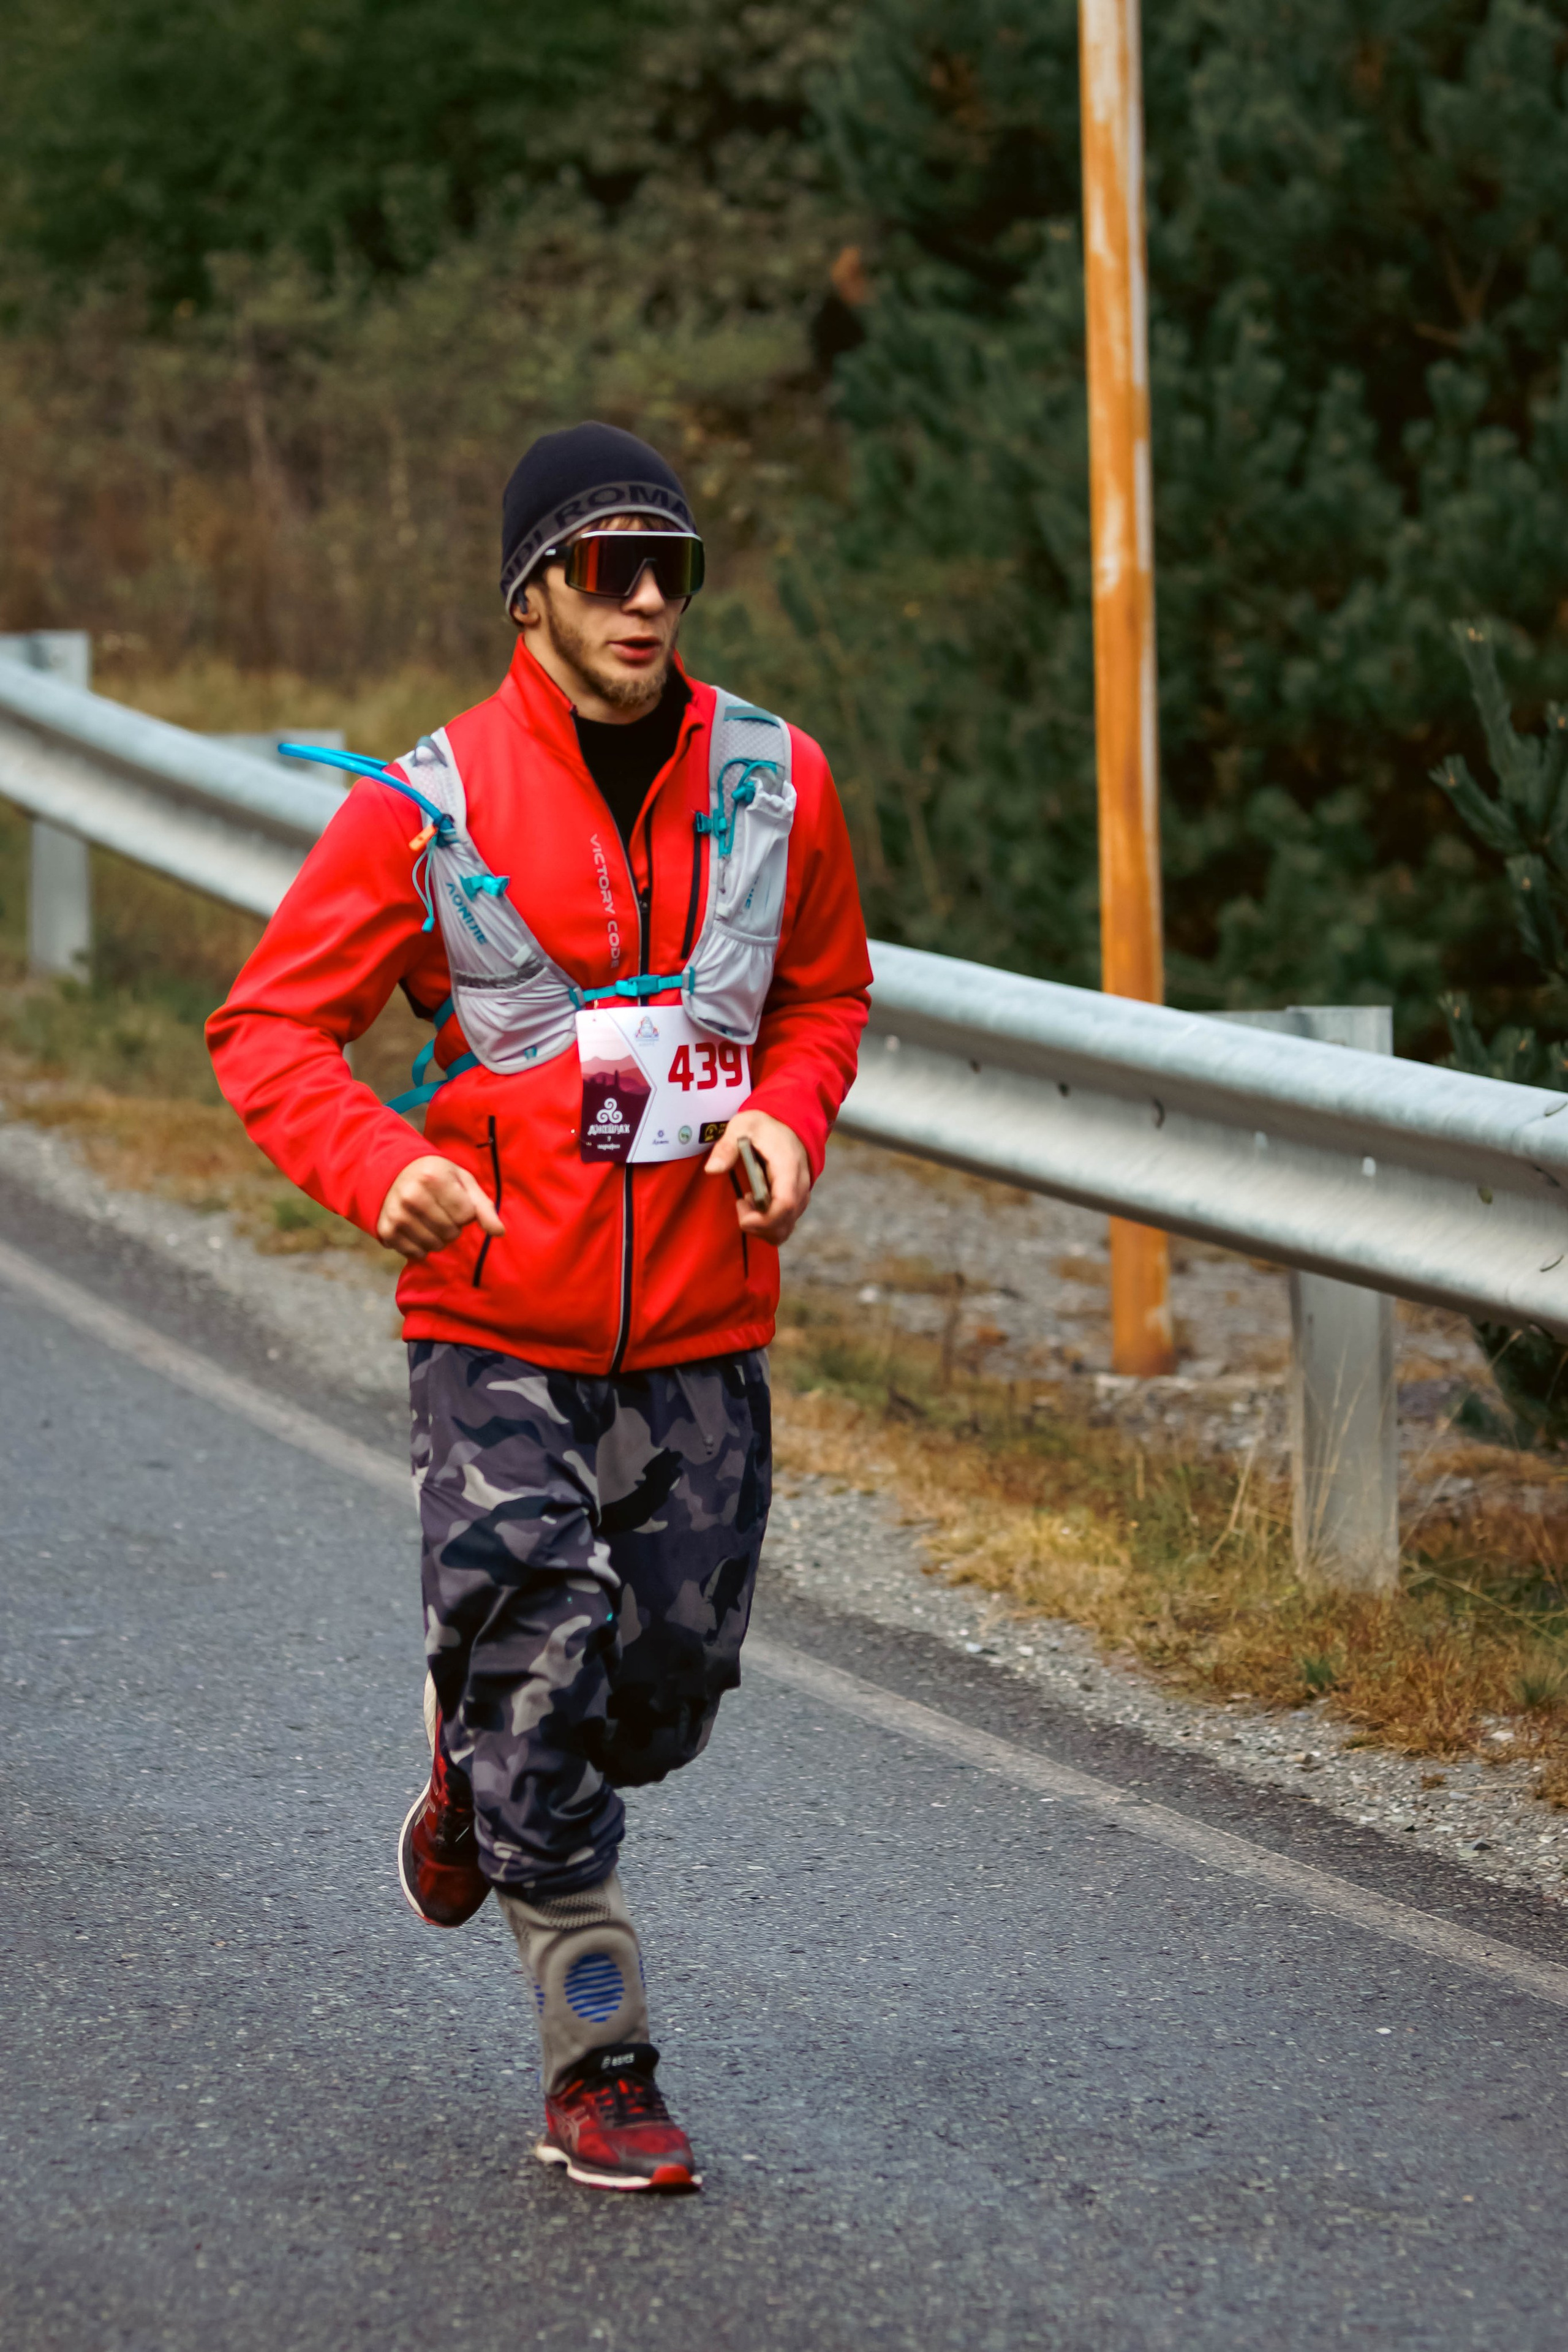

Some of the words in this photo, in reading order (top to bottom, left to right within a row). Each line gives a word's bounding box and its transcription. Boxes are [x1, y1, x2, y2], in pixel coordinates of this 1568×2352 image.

[554, 484, 689, 529] ROMA
[590, 834, 616, 914] VICTORY
[608, 921, 620, 968] CODE
[668, 1041, 743, 1091] 439
